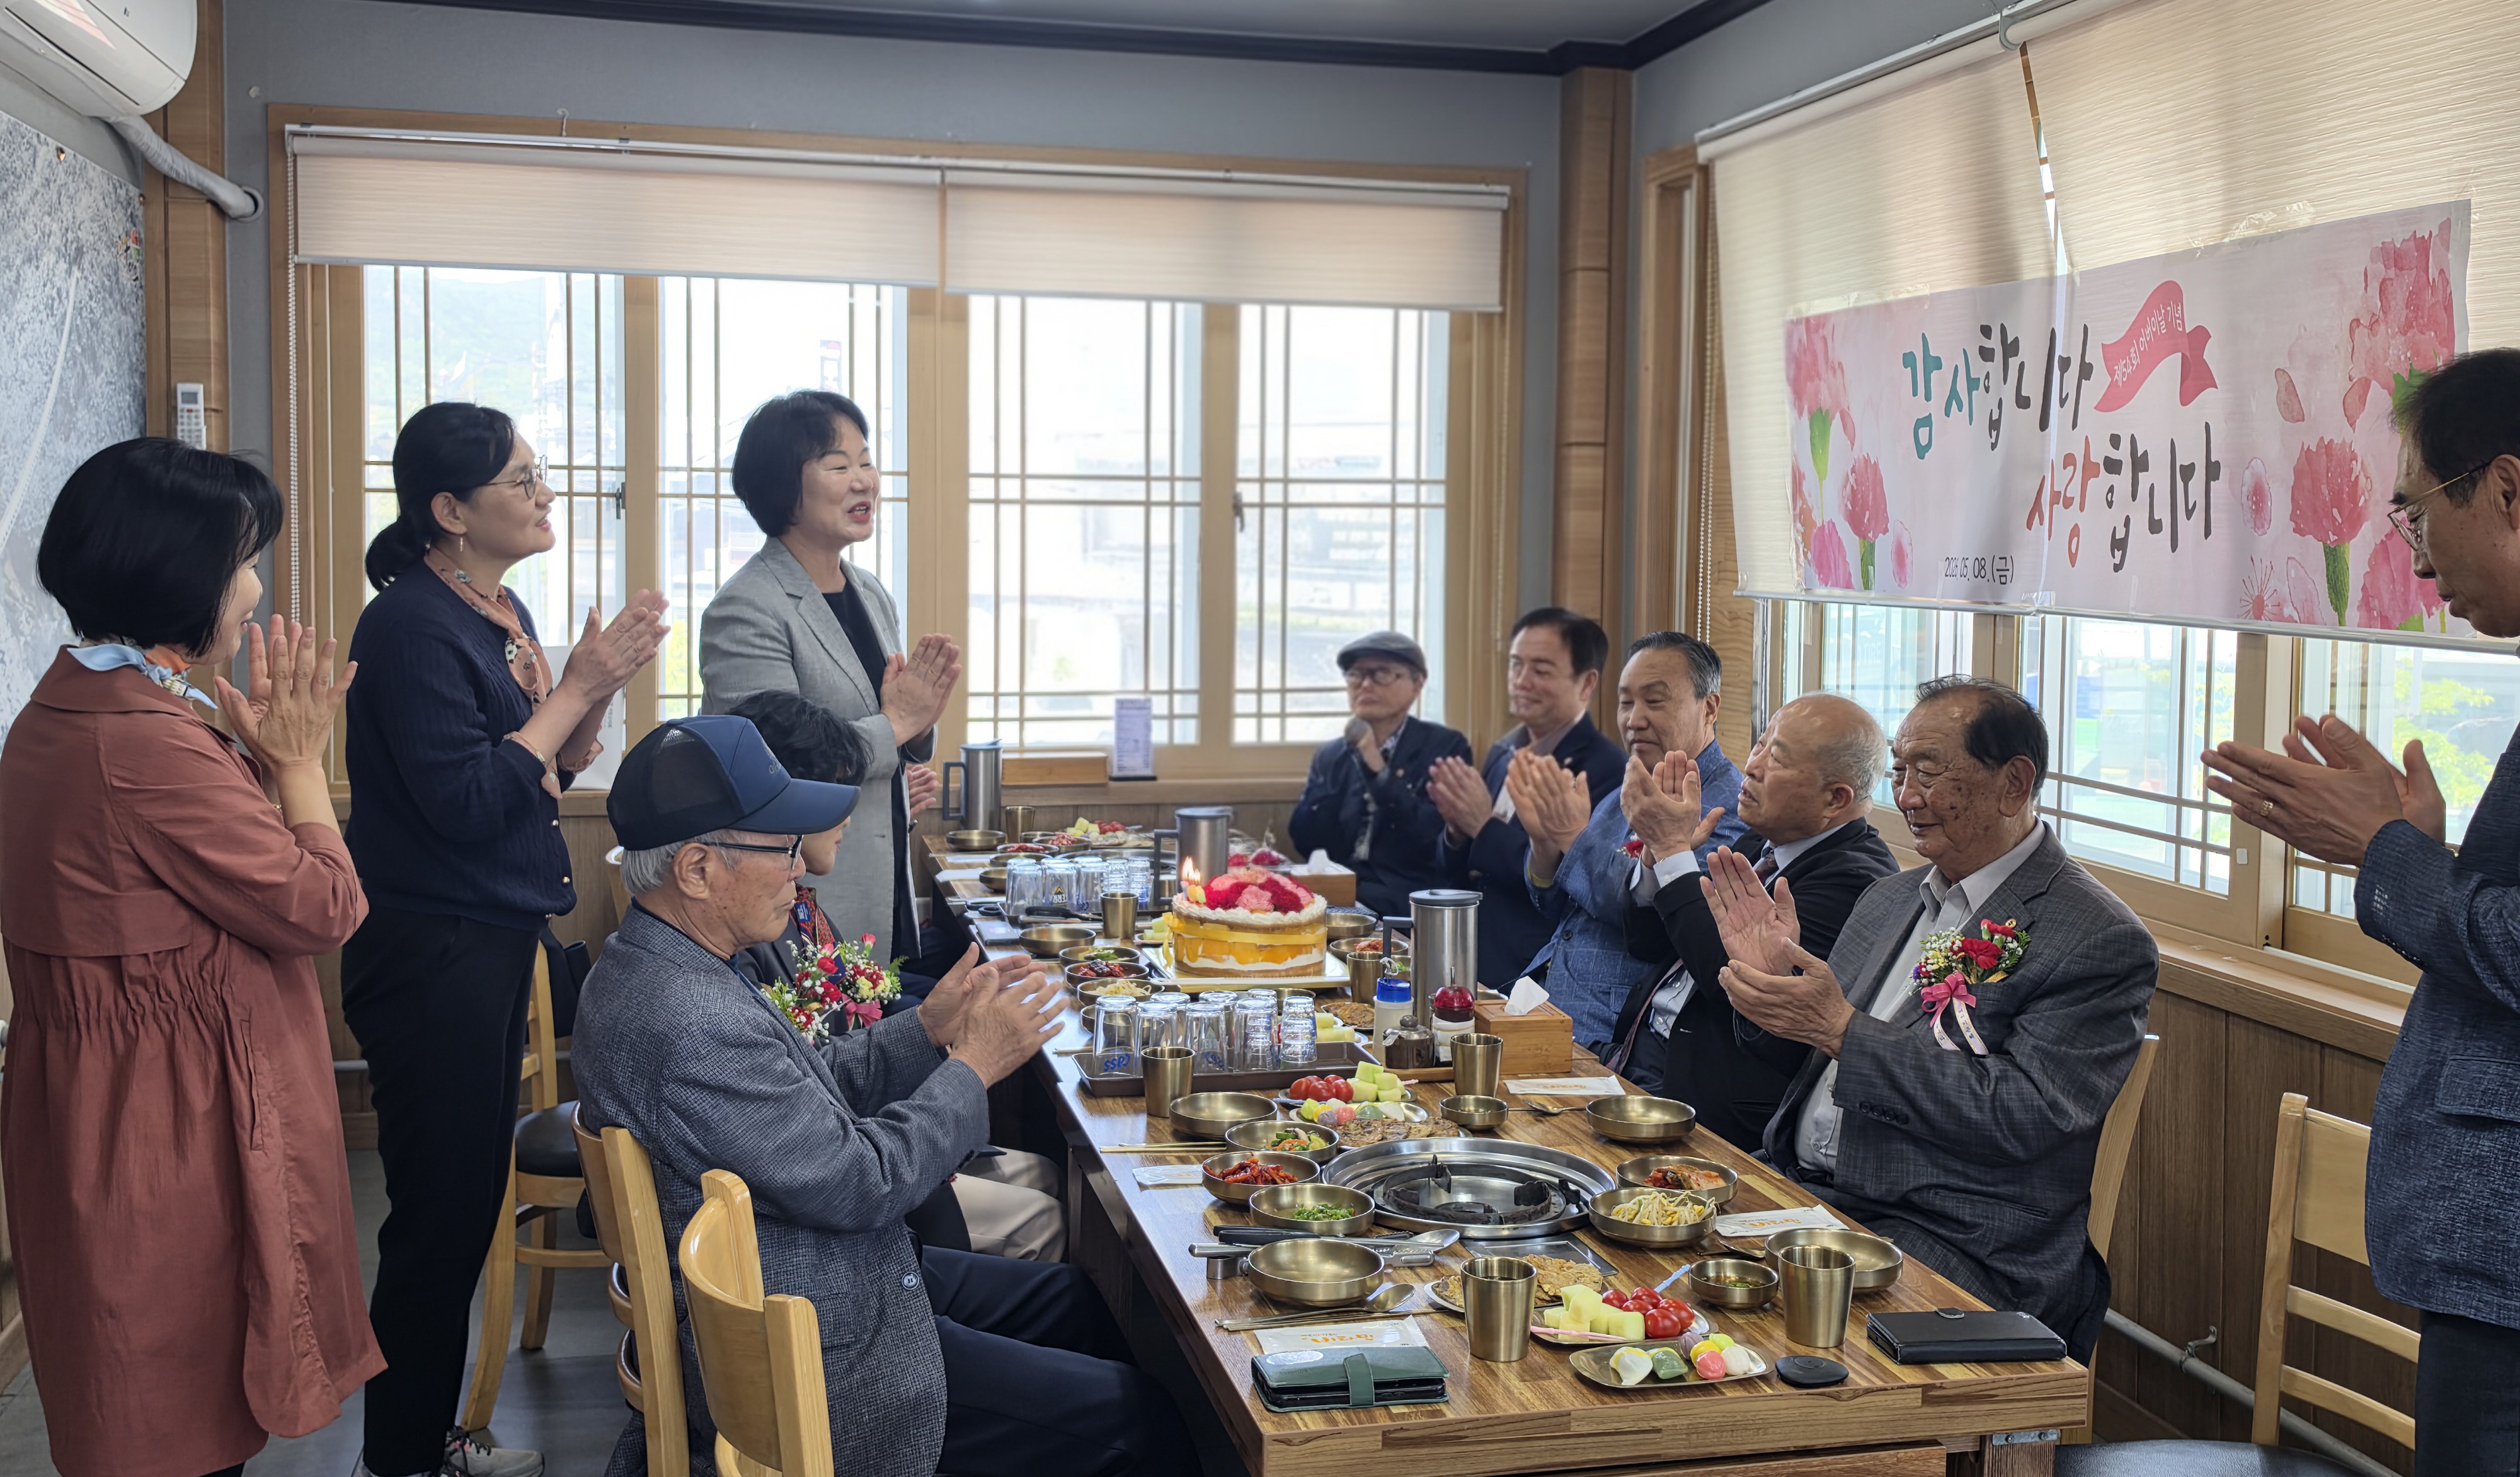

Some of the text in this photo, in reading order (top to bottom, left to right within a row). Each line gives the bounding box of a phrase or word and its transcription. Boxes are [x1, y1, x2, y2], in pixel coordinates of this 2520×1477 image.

[1902, 322, 2094, 460] 감사합니다
[2113, 301, 2182, 388] 제54회 어버이날 기념
[2026, 421, 2221, 573] 사랑합니다
